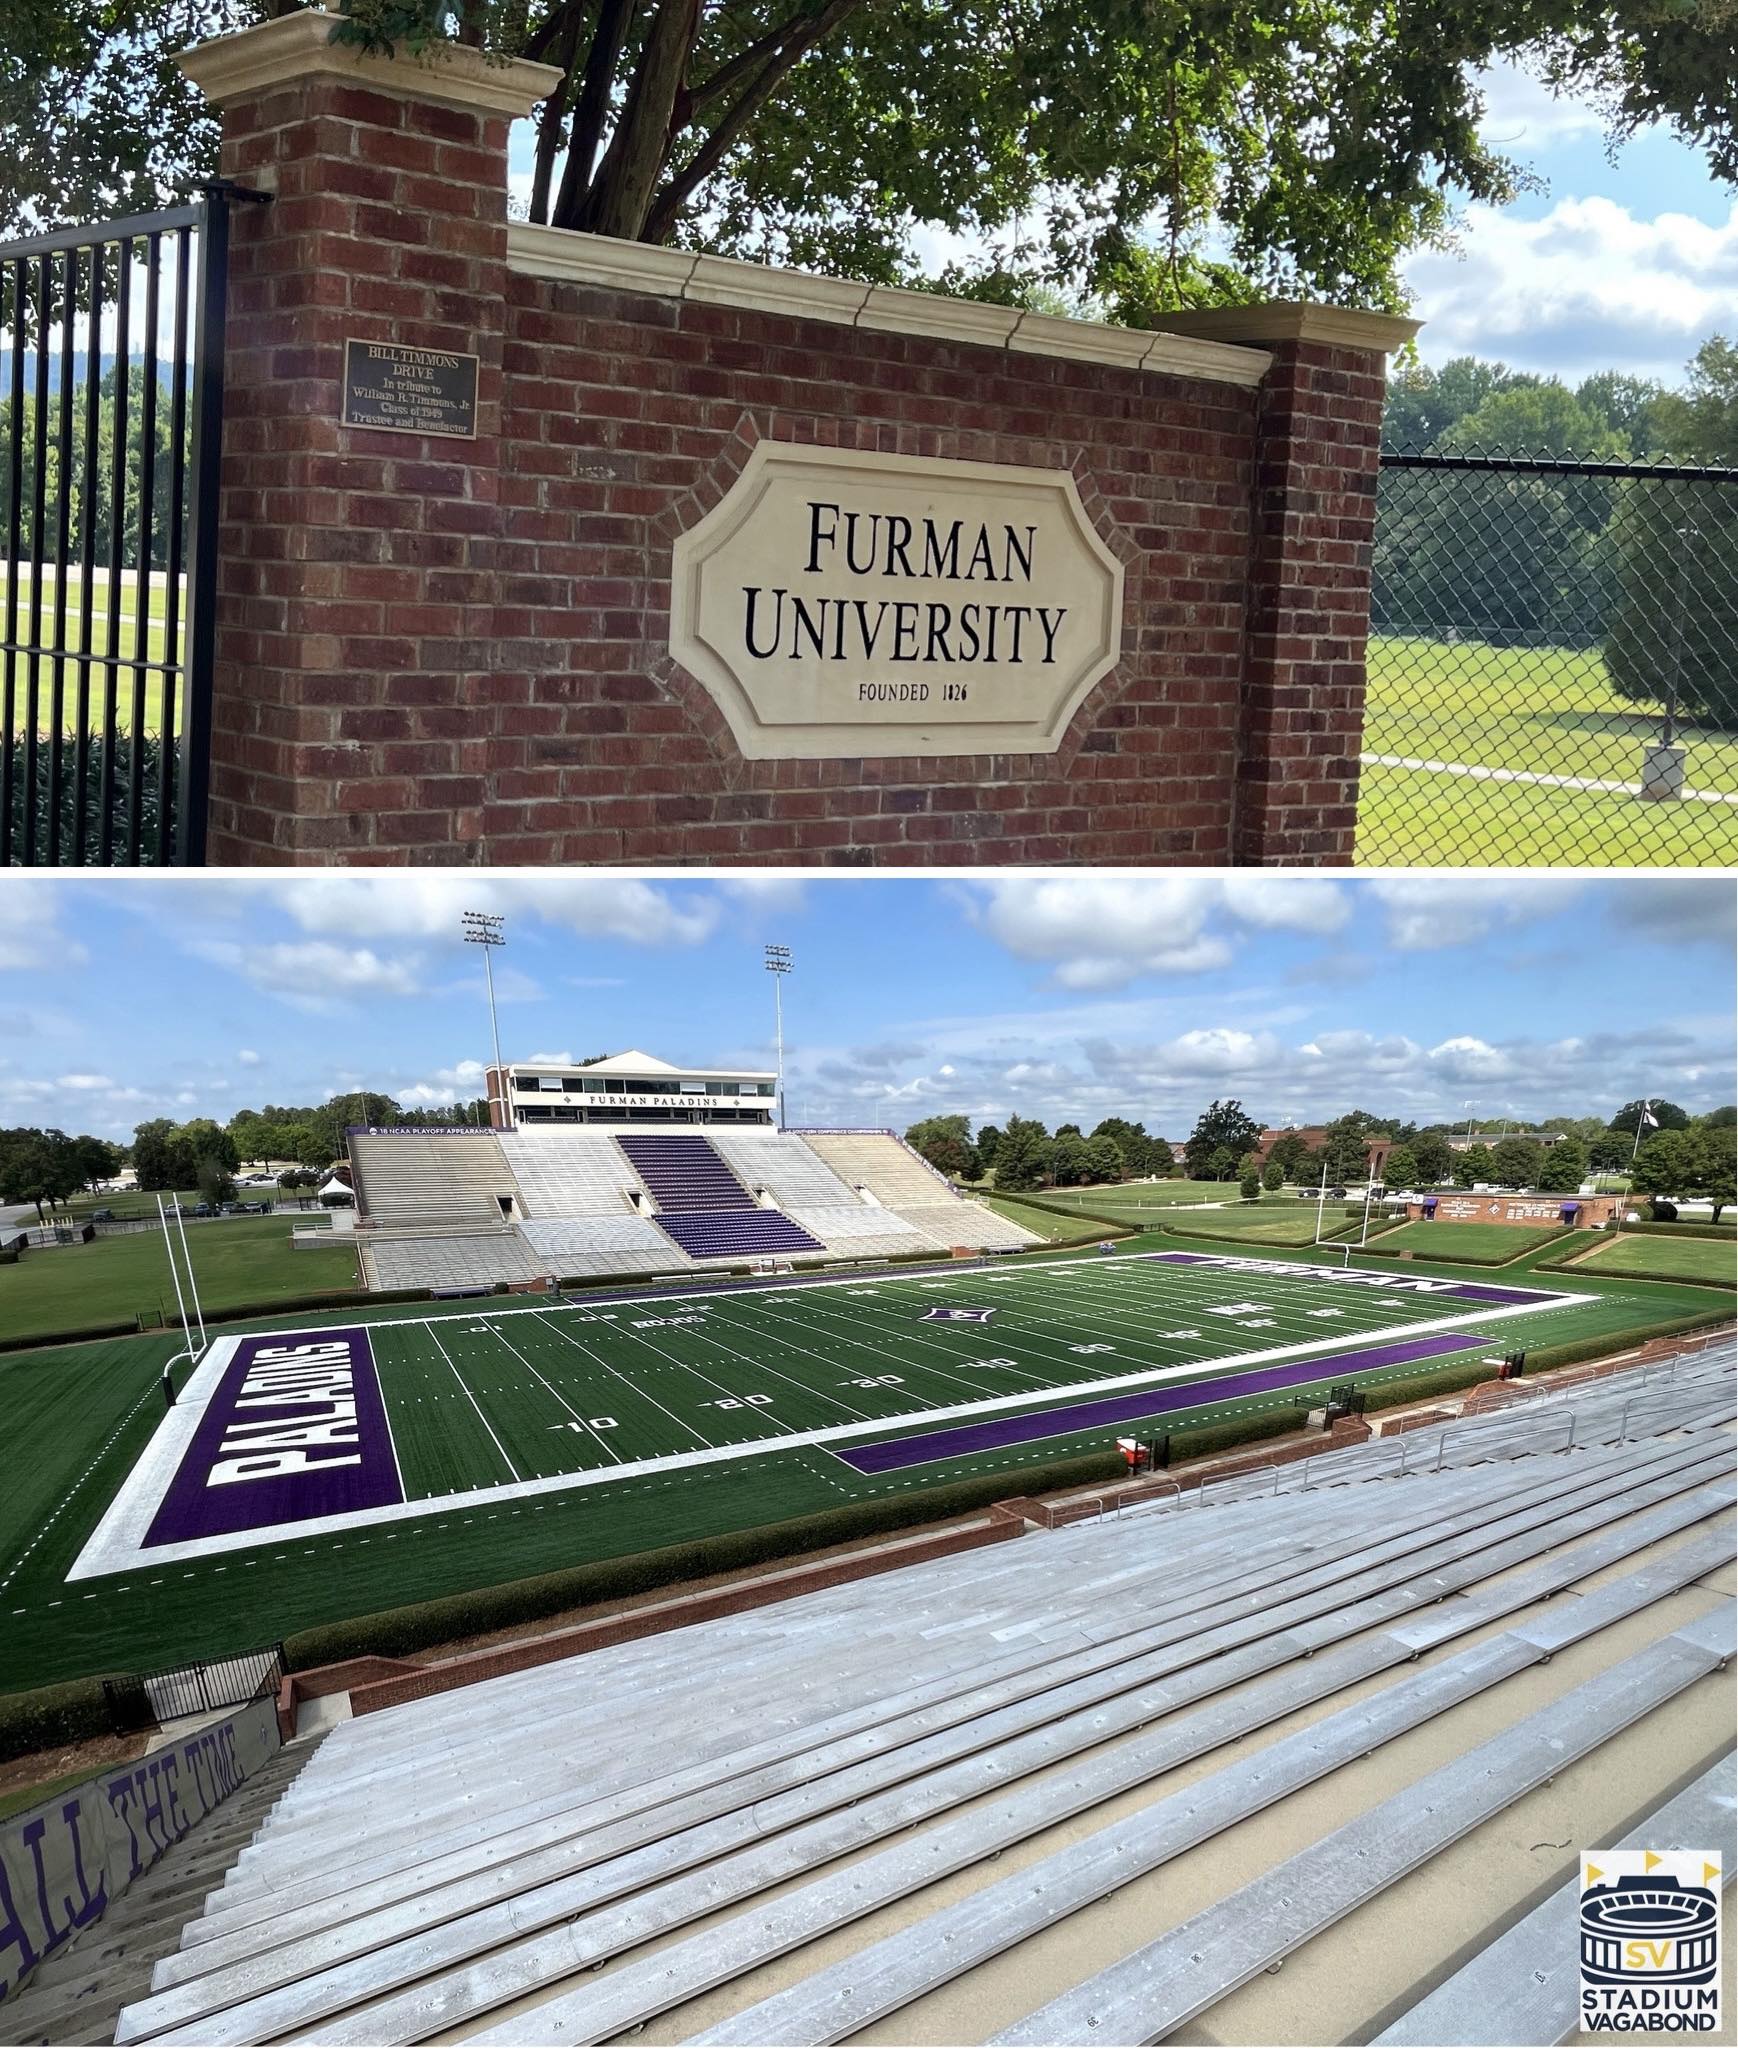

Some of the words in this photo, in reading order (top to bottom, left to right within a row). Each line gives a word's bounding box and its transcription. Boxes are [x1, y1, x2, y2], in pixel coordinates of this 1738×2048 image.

[368, 346, 398, 361] BILL
[399, 350, 459, 369] TIMMONS
[392, 364, 434, 380] DRIVE
[353, 386, 395, 401] William
[383, 377, 395, 389] In
[396, 380, 430, 394] tribute
[432, 385, 442, 395] to
[380, 402, 408, 415] Class
[411, 405, 420, 416] of
[421, 407, 443, 419] 1949
[352, 412, 393, 425] Trustee
[395, 415, 414, 428] and
[417, 419, 468, 434] Benefactor
[803, 502, 1037, 583] FURMAN
[742, 587, 1068, 664] UNIVERSITY
[858, 683, 929, 701] FOUNDED
[942, 684, 967, 701] 1826
[590, 1096, 647, 1105] FURMAN
[653, 1097, 718, 1106] PALADINS
[1191, 1259, 1464, 1292] FURMAN
[850, 1374, 906, 1388] 30
[714, 1394, 774, 1409] 20
[206, 1341, 361, 1487] PALADINS
[567, 1416, 619, 1433] 10
[107, 1752, 191, 1883] THE
